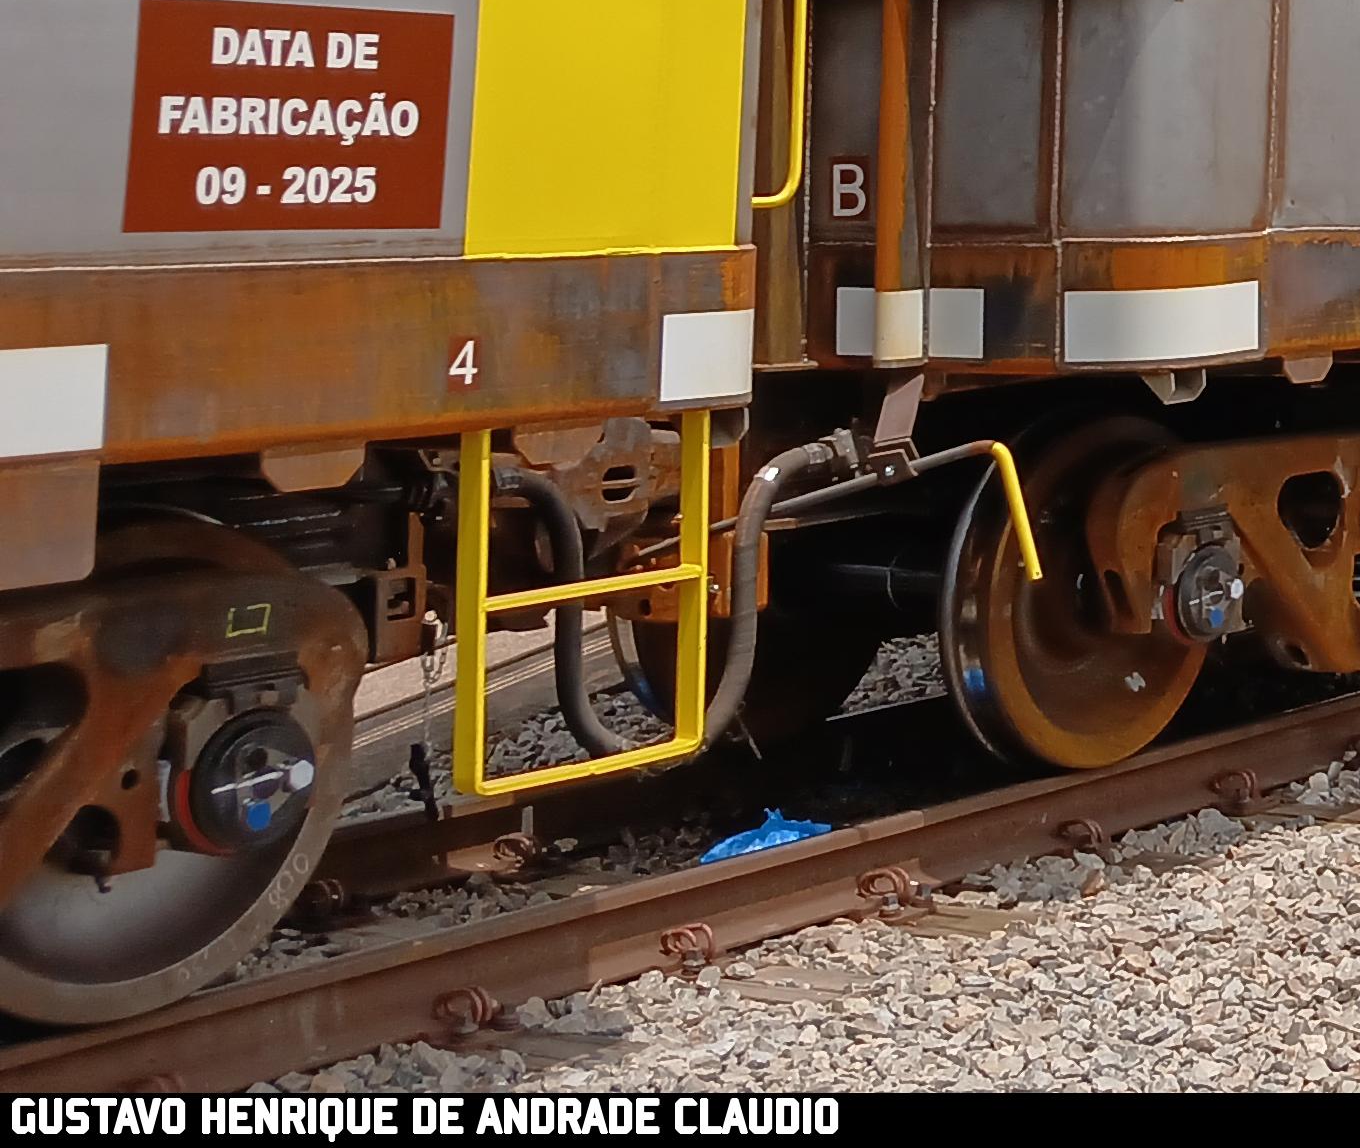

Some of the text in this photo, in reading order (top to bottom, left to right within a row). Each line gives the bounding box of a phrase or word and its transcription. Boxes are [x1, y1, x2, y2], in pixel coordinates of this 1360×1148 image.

[211, 27, 380, 69] DATA DE
[158, 92, 420, 146] FABRICAÇÃO
[195, 166, 246, 205] 09
[280, 166, 377, 204] 2025
[833, 163, 867, 217] B
[448, 340, 478, 385] 4
